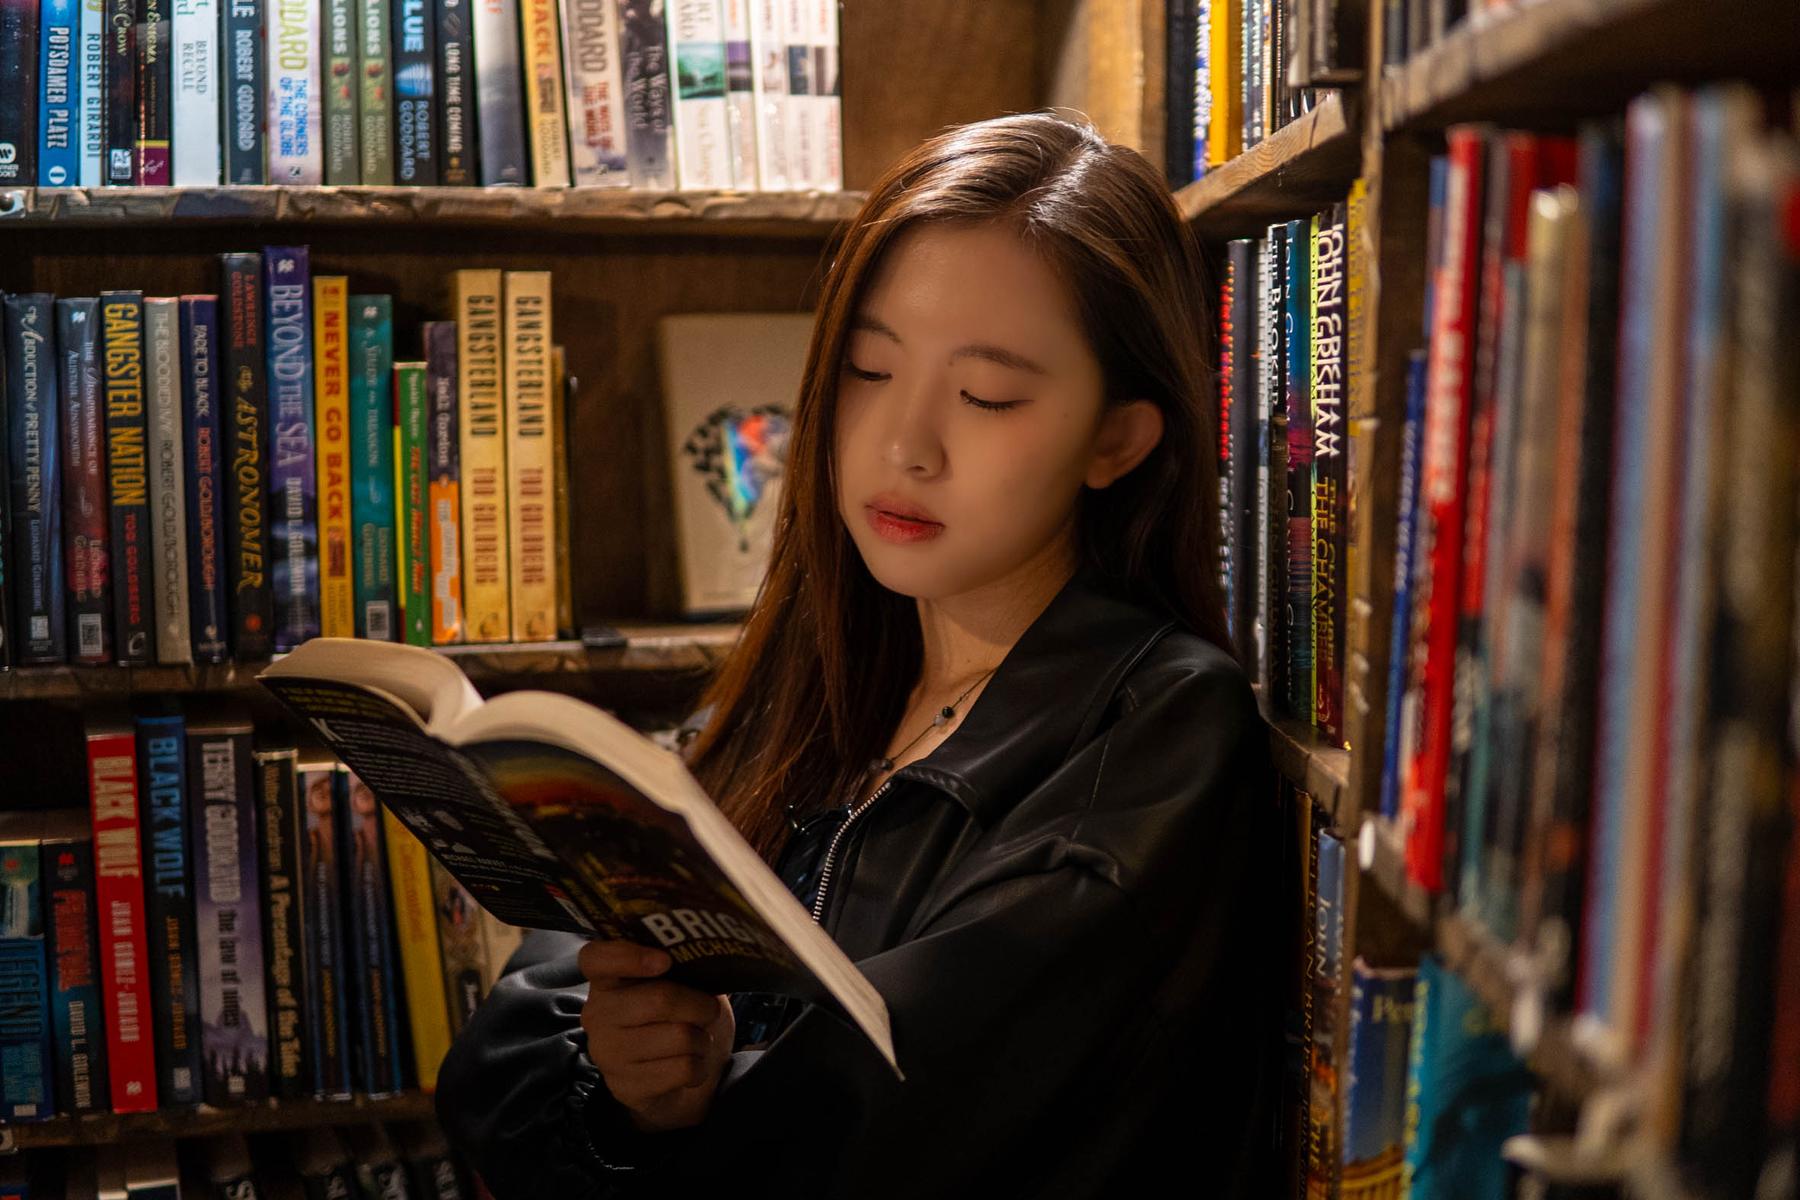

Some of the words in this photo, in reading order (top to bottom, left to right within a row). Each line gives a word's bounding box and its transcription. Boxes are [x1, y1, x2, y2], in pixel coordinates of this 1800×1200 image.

[113, 13, 132, 56] CROW
[147, 12, 161, 64] ENIGMA
[332, 0, 347, 54] LIONS
[365, 0, 381, 55] LIONS
[403, 0, 424, 52] LUE
[47, 27, 70, 103] POTSDAMER
[86, 34, 101, 90] ROBERT
[183, 43, 194, 90] RECALL
[196, 41, 208, 94] BEYOND
[236, 29, 254, 81] ROBERT
[445, 42, 461, 73] LONG
[647, 46, 664, 71] The
[280, 77, 292, 90] OF
[280, 96, 292, 116] THE
[295, 80, 307, 99] THE
[446, 76, 461, 104] TIME
[630, 78, 648, 129] World
[648, 73, 667, 115] Ways
[47, 110, 69, 148] PLATZ
[86, 97, 101, 158] GIRARDI
[237, 84, 256, 151] GODDARD
[280, 120, 293, 156] GLOBE
[295, 103, 308, 156] CORNERS
[332, 114, 342, 172] GODDARD
[342, 114, 352, 159] ROBERT
[376, 115, 386, 160] ROBERT
[400, 100, 415, 180] GODDARD
[416, 100, 431, 160] ROBERT
[447, 106, 462, 153] COMING
[366, 116, 376, 174] GODDARD
[1285, 237, 1294, 299] JOHN
[1316, 229, 1333, 308] JOHN
[155, 312, 169, 338] THE
[231, 271, 244, 348] GOLDSTONE
[245, 274, 257, 346] LAWRENCE
[270, 284, 305, 381] BEYOND
[104, 303, 142, 418] GANGSTER
[194, 325, 208, 355] FADE
[324, 311, 341, 397] NEVER
[467, 295, 498, 438] GANGSTERLAND
[1271, 285, 1282, 406] BROKER
[195, 358, 208, 376] TO
[515, 296, 544, 438] GANGSTERLAND
[1285, 312, 1294, 423] GRISHAM
[1315, 316, 1333, 458] GRISHAM
[158, 408, 173, 434] IVY
[196, 377, 210, 417] BLACK
[279, 384, 303, 417] THE
[25, 412, 39, 465] PRETTY
[197, 426, 212, 473] ROBERT
[276, 422, 308, 468] SEA
[326, 407, 342, 443] GO
[26, 466, 40, 513] PENNY
[109, 427, 146, 505] NATION
[160, 441, 175, 492] ROBERT
[326, 452, 344, 520] BACK
[472, 466, 497, 497] TOD
[520, 466, 545, 496] TOD
[232, 396, 263, 593] ASTRONOMER
[286, 477, 303, 518] DAVID
[1316, 477, 1329, 529] THE
[125, 513, 137, 542] TOD
[198, 476, 215, 591] GOLDSBOROUGH
[473, 504, 498, 586] GOLDBERG
[520, 503, 546, 586] GOLDBERG
[162, 493, 180, 617] GOLDSBOROUGH
[126, 545, 141, 624] GOLDBERG
[1316, 538, 1329, 663] CHAMBER
[92, 755, 137, 822] BLACK
[148, 737, 181, 823] BLACK
[202, 738, 236, 802] TERRY
[97, 826, 140, 879] WOLF
[153, 826, 186, 898] WOLF
[205, 804, 242, 903] GOODKIND
[270, 875, 290, 889] A
[1306, 834, 1318, 981] PELICAN
[110, 900, 134, 937] JUAN
[271, 892, 295, 985] Percentage
[641, 908, 770, 948] BRIG
[1316, 896, 1332, 977] JOHN
[68, 1000, 86, 1036] DAVID
[276, 988, 298, 1007] of
[278, 1009, 299, 1038] the
